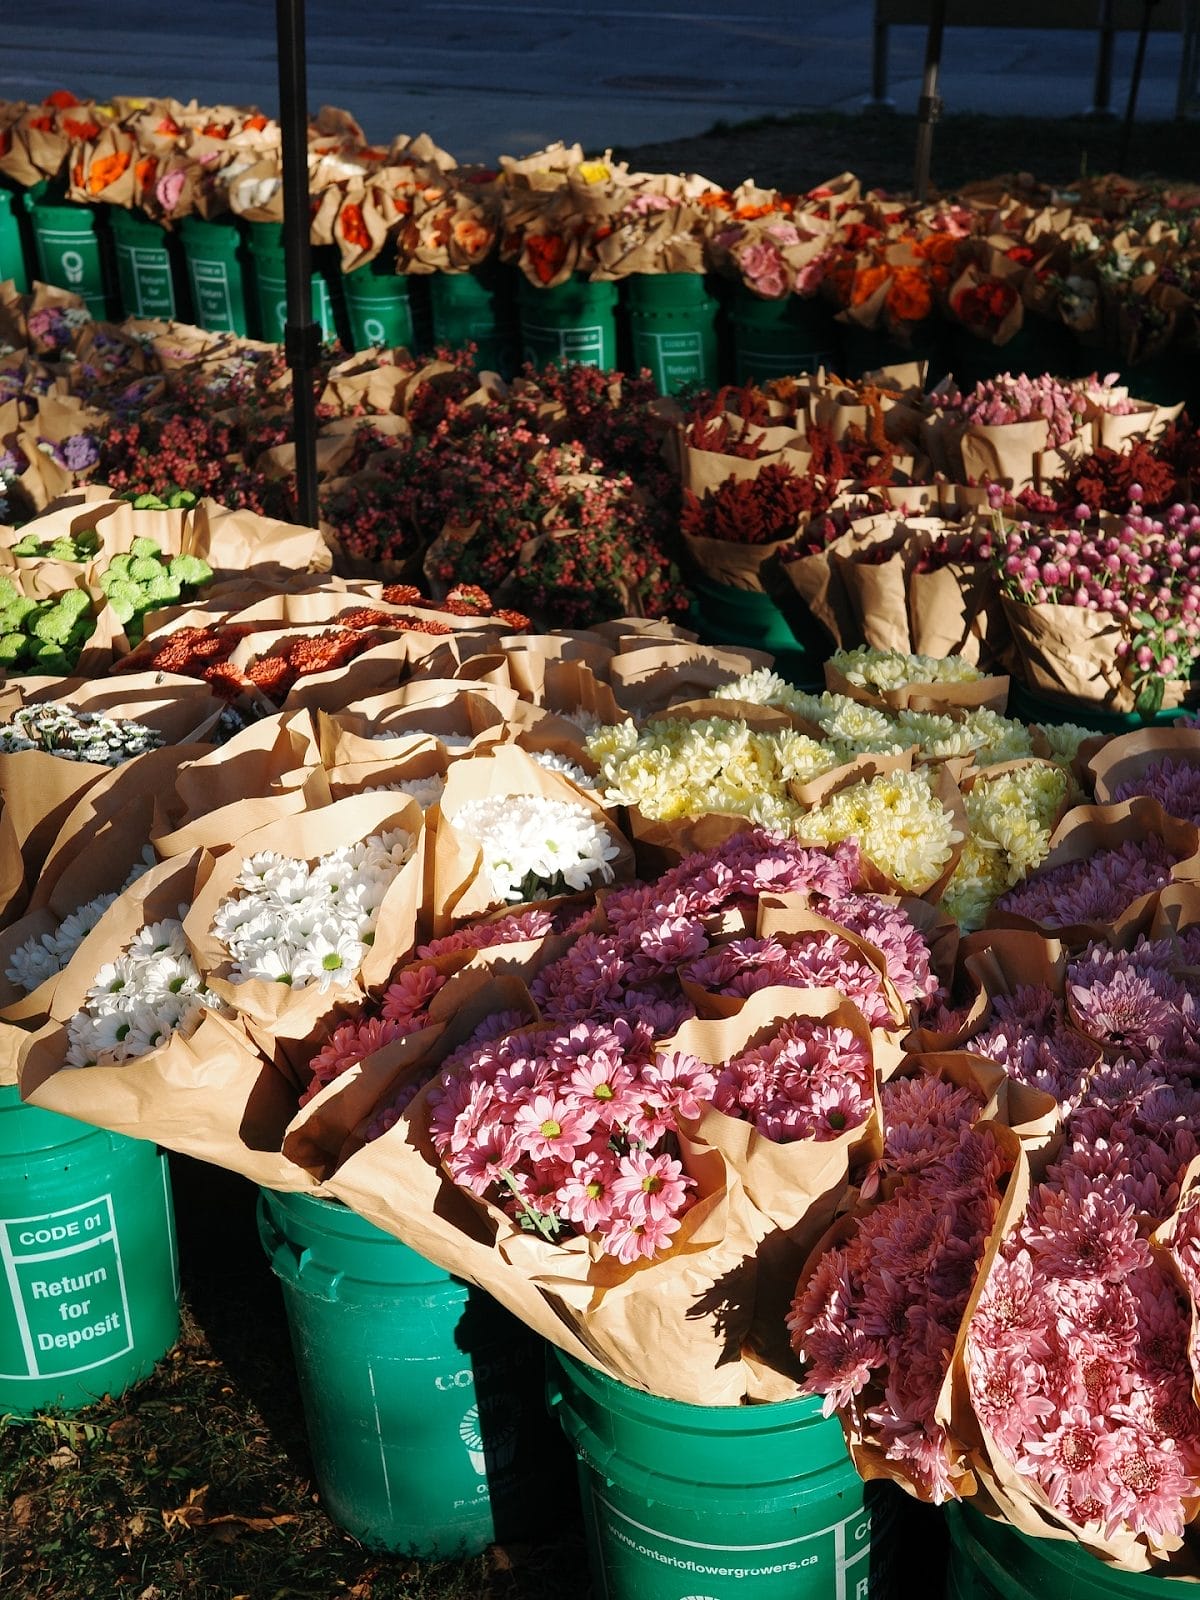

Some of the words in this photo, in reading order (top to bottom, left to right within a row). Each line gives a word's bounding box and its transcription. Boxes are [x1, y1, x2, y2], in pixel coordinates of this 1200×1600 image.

[19, 1222, 81, 1246] CODE
[84, 1213, 102, 1231] 01
[31, 1267, 107, 1300] Return
[58, 1299, 91, 1321] for
[37, 1312, 120, 1351] Deposit
[608, 1523, 819, 1579] www.ontarioflowergrowers.ca
